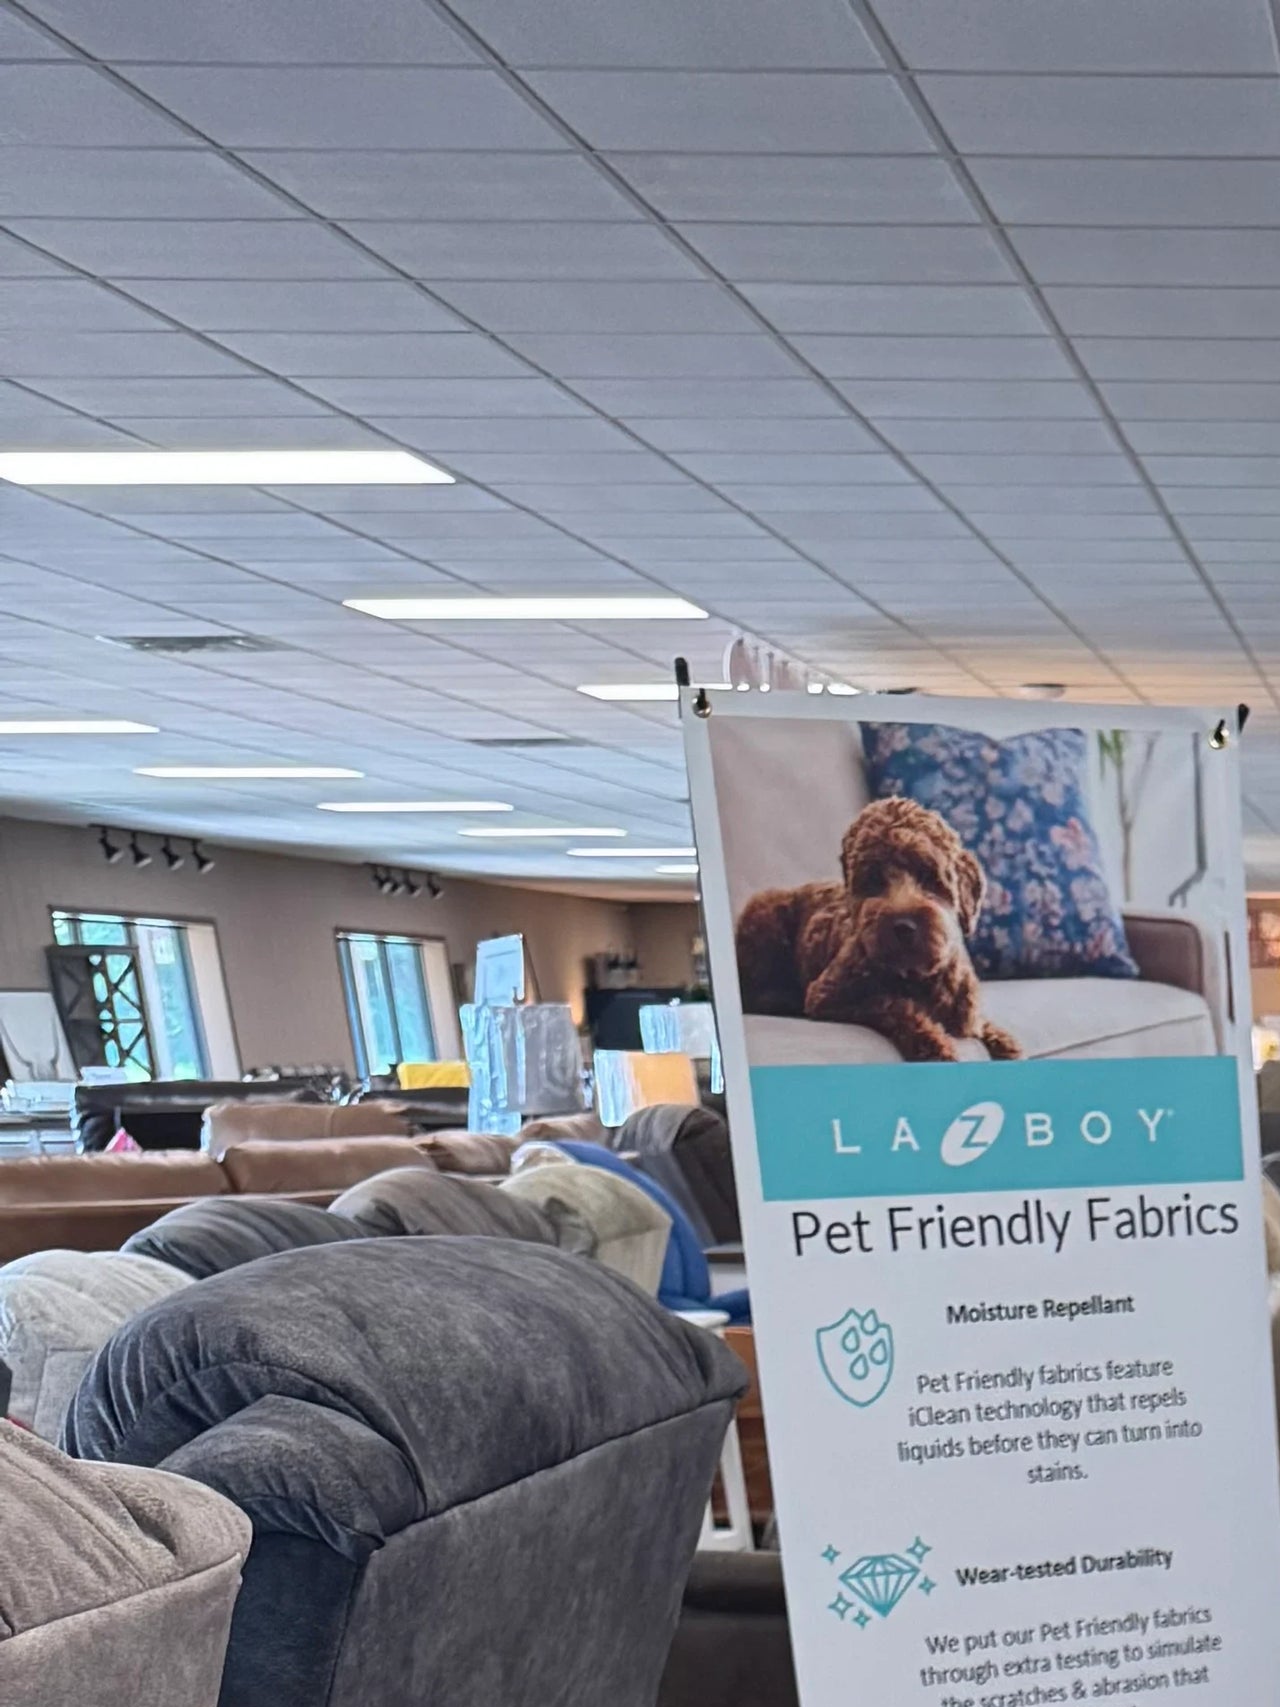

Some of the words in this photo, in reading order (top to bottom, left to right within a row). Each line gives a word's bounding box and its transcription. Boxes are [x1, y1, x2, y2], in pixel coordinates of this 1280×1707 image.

[793, 1210, 873, 1257] Pet
[888, 1200, 1071, 1253] Friendly
[1087, 1193, 1239, 1242] Fabrics
[946, 1303, 1038, 1324] Moisture
[1042, 1296, 1135, 1322] Repellant
[917, 1374, 950, 1394] Pet
[955, 1367, 1034, 1391] Friendly
[1038, 1363, 1102, 1385] fabrics
[1106, 1360, 1173, 1380] feature
[909, 1406, 971, 1427] iClean
[975, 1398, 1082, 1422] technology
[1087, 1393, 1126, 1413] that
[1130, 1389, 1187, 1413] repels
[897, 1438, 965, 1465] liquids
[968, 1434, 1033, 1455] before
[1037, 1430, 1080, 1452] they
[1084, 1429, 1118, 1446] can
[1121, 1425, 1162, 1443] turn
[1165, 1420, 1202, 1439] into
[955, 1557, 1077, 1587] Wear-tested
[1081, 1549, 1173, 1574] Durability
[926, 1635, 959, 1655] We
[964, 1630, 997, 1656] put
[1002, 1629, 1035, 1647] our
[1040, 1621, 1071, 1642] Pet
[1075, 1612, 1149, 1638] Friendly
[1153, 1606, 1212, 1628] fabrics
[920, 1660, 999, 1687] through
[1003, 1656, 1051, 1677] extra
[1055, 1648, 1120, 1670] testing
[1123, 1644, 1143, 1662] to
[1147, 1634, 1222, 1659] simulate
[1072, 1680, 1087, 1700] &
[1092, 1673, 1169, 1697] abrasion
[1173, 1666, 1209, 1687] that
